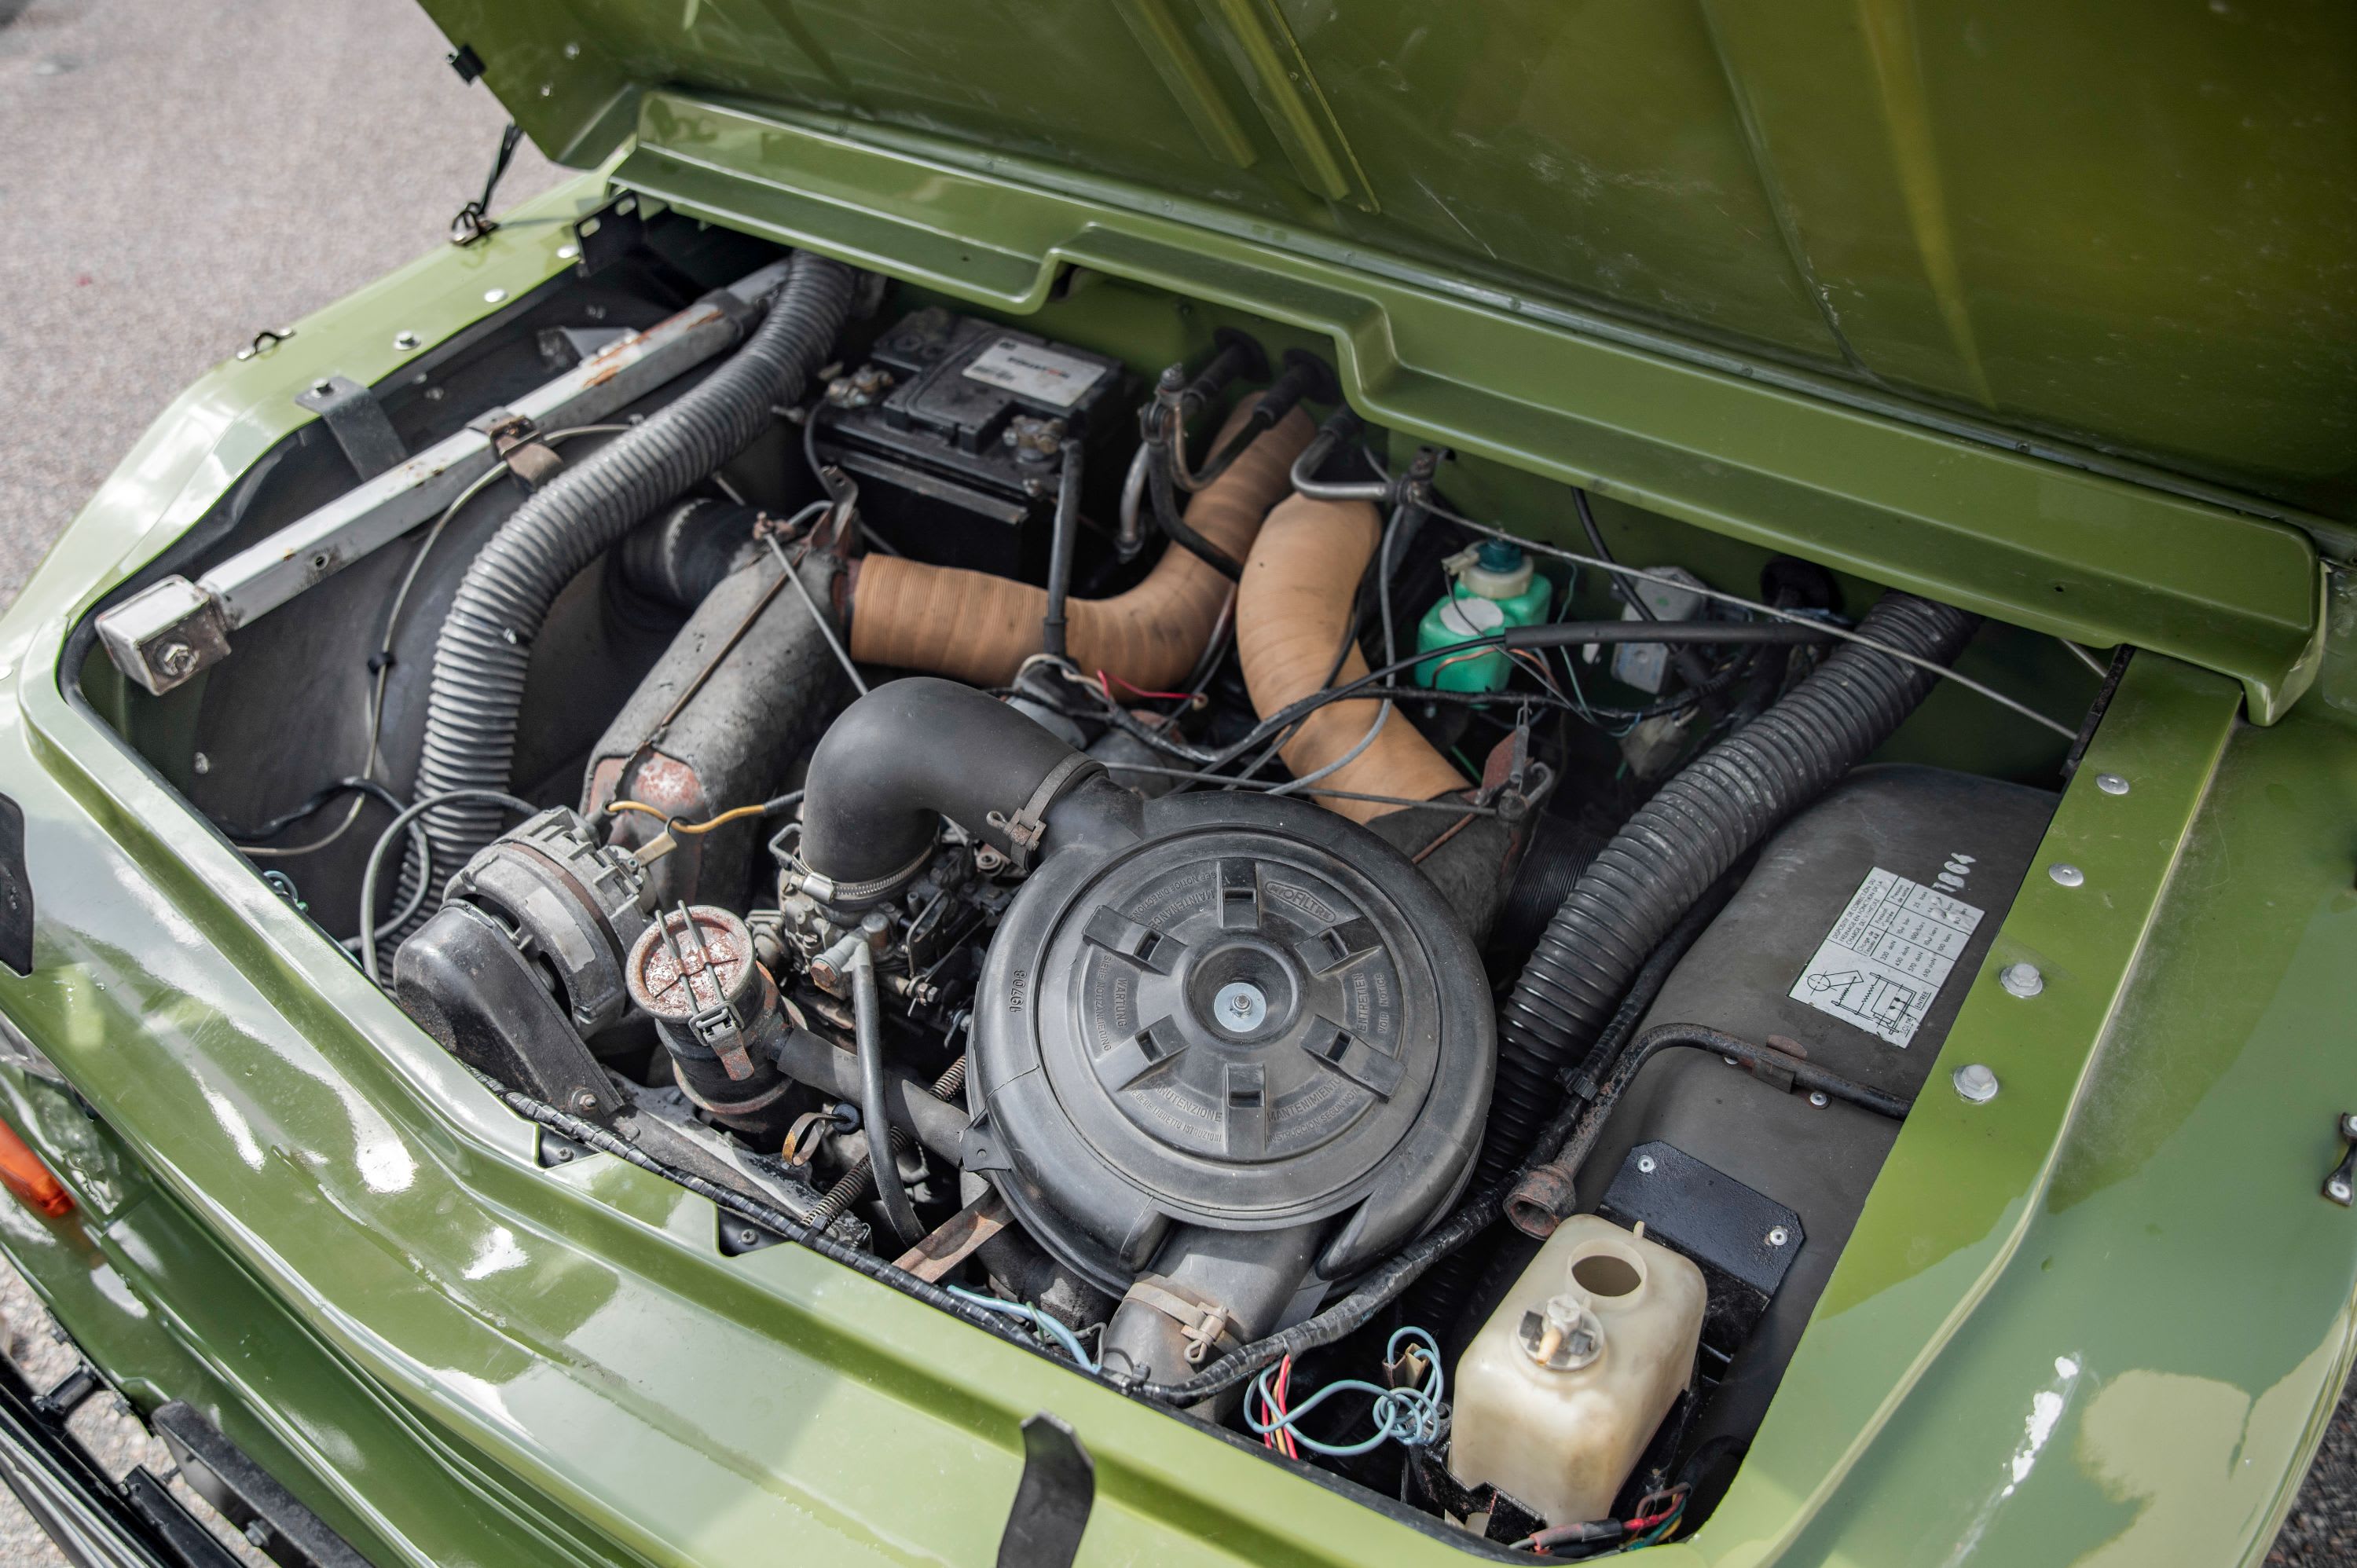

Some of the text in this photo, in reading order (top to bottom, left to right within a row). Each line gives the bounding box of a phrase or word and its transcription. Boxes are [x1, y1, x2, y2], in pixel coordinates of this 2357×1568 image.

[1148, 889, 1215, 931] MAINTENANCE
[1838, 920, 1857, 942] FREINAGE
[1845, 926, 1861, 945] CHARGE
[1098, 955, 1112, 980] SIEHE
[1879, 951, 1890, 960] 320
[1907, 962, 1917, 972] 570
[1009, 969, 1028, 1013] 19708
[1114, 978, 1127, 1028] WARTUNG
[1352, 973, 1369, 1032] ENTRETIEN
[1375, 973, 1389, 1033] VOIR NOTICE
[1266, 1077, 1342, 1123] MANTENIMIENTO
[1266, 1117, 1321, 1143] INSTRUCCION
